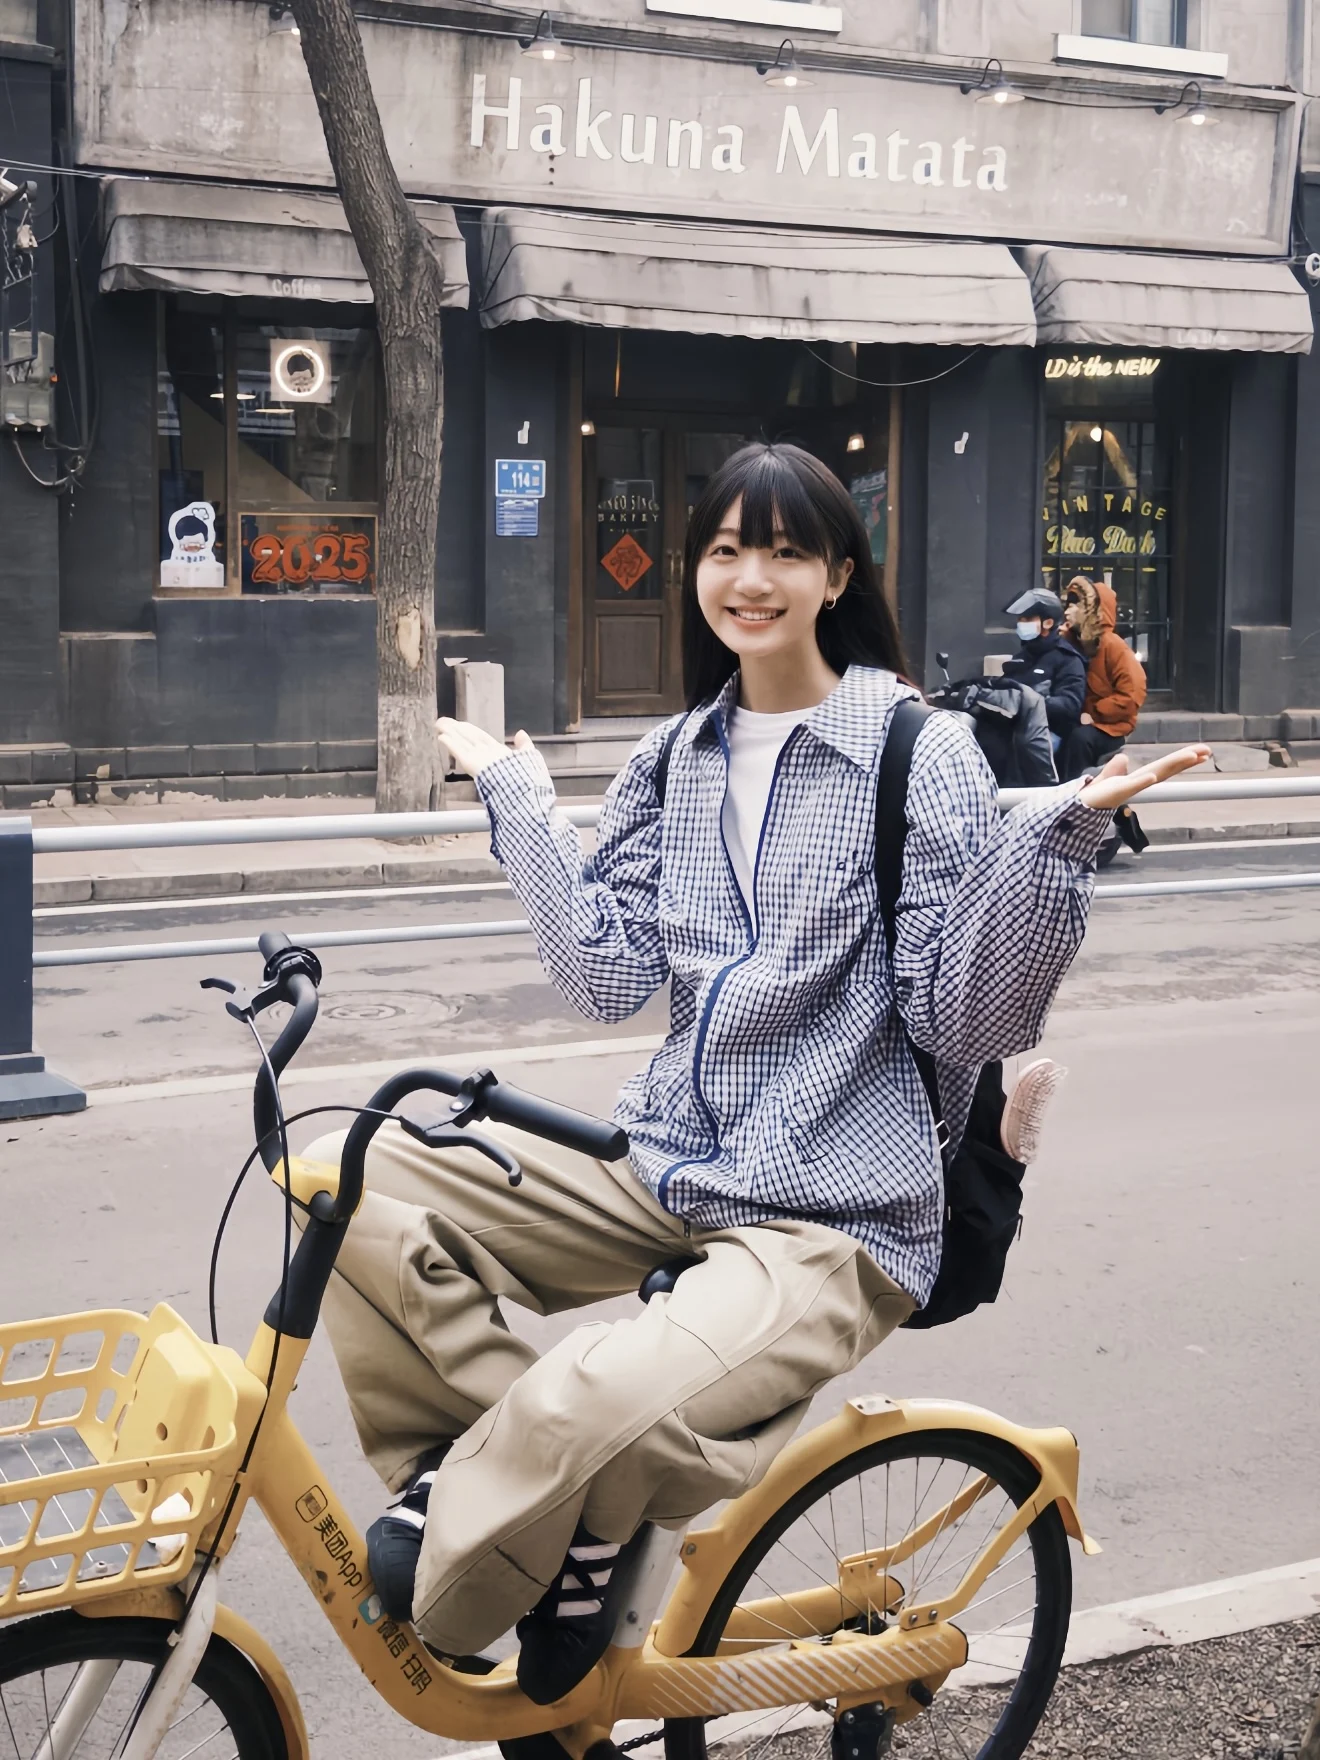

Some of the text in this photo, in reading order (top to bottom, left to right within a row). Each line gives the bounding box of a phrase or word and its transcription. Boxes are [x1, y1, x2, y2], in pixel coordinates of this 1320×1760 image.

[469, 73, 1009, 192] Hakuna Matata
[272, 278, 322, 298] Coffee
[1083, 355, 1113, 377] the
[1114, 357, 1161, 376] NEW
[512, 471, 530, 488] 114
[250, 533, 370, 584] 2025
